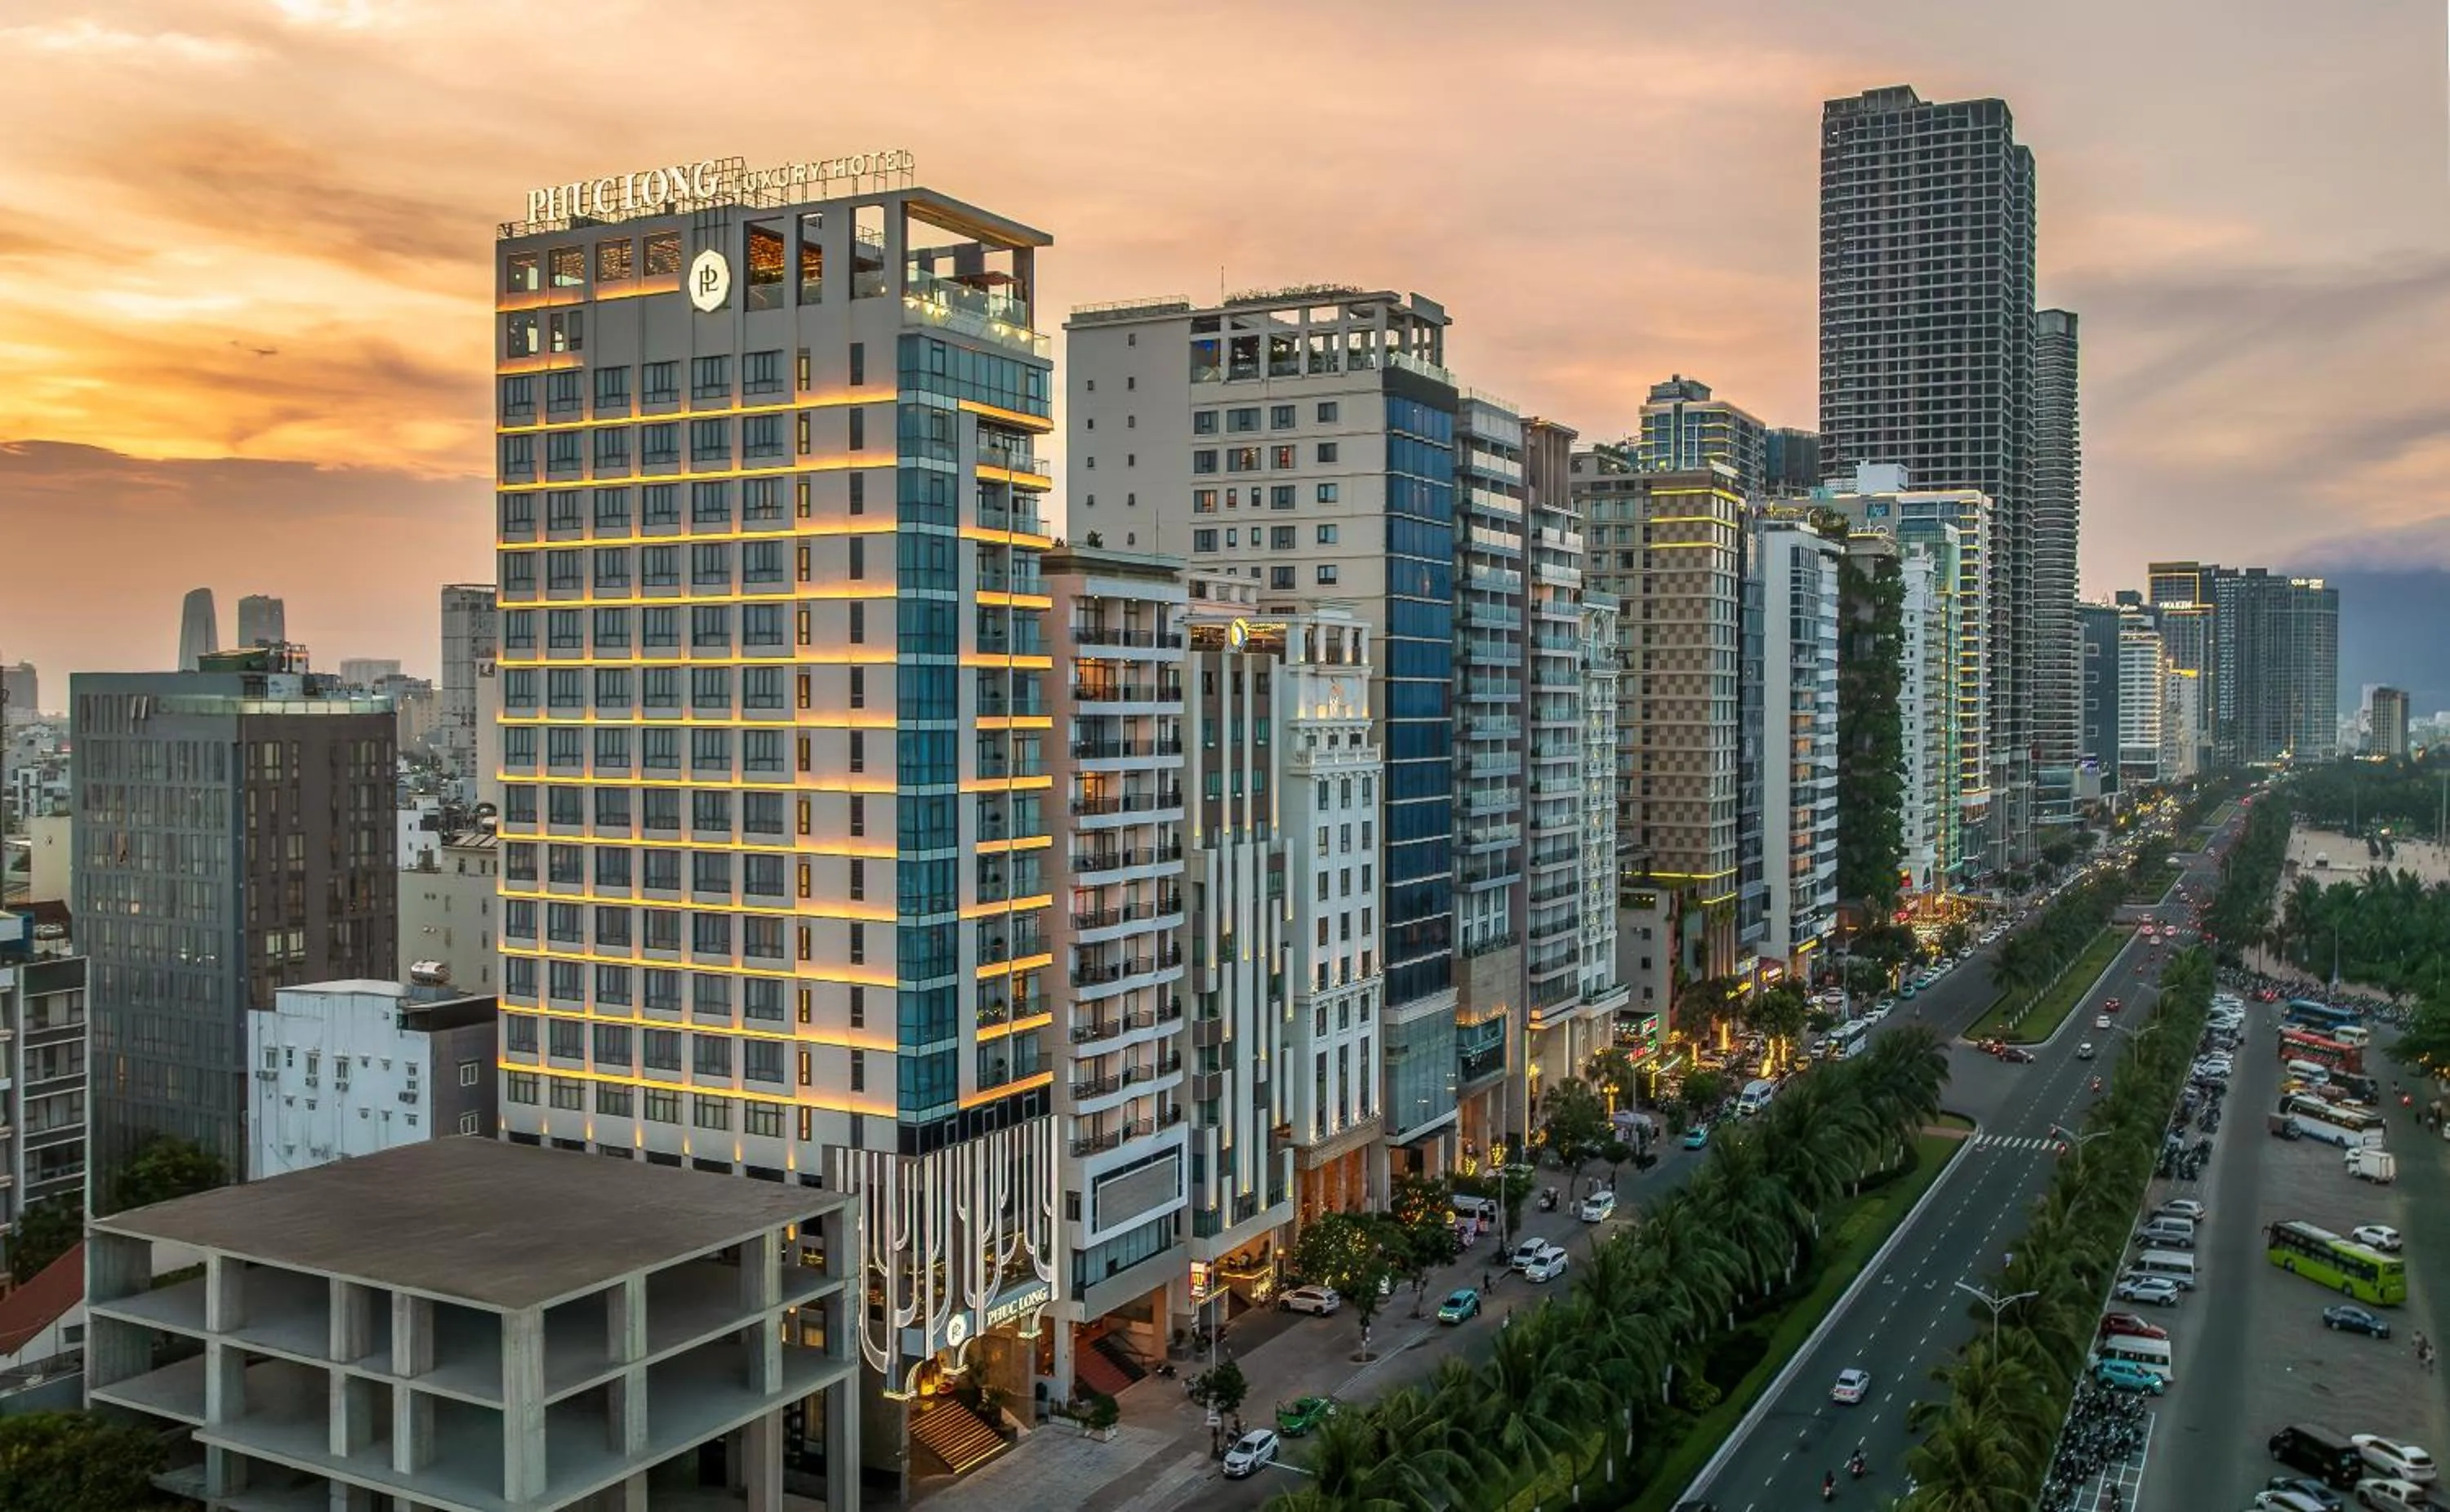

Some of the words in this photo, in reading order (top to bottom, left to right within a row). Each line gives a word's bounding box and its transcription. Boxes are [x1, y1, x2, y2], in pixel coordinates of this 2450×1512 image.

[527, 179, 616, 225] PHUC
[624, 160, 721, 210] LONG
[733, 161, 822, 193] LUXURY
[833, 149, 914, 179] HOTEL
[1018, 1286, 1047, 1310] LONG
